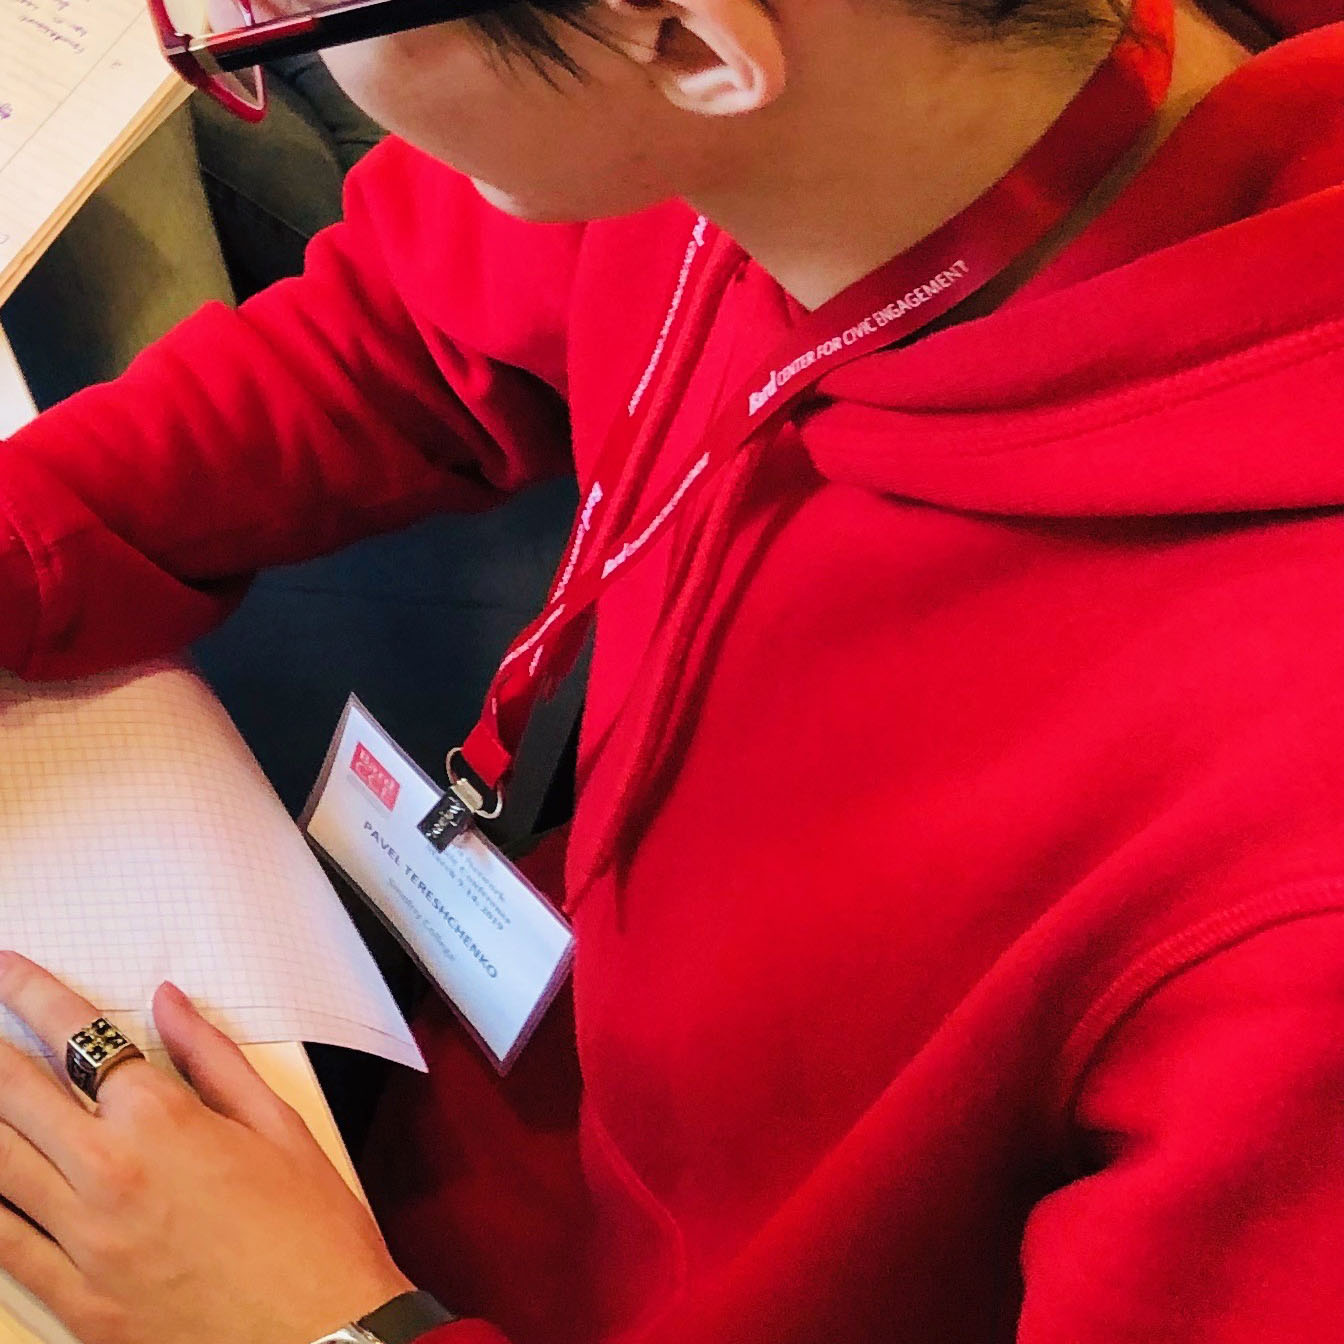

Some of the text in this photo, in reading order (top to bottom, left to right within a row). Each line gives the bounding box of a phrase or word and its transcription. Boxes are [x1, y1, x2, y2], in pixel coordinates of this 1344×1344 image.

[816, 336, 843, 361] FOR
[842, 316, 878, 346] CIVIC
[873, 259, 970, 328] ENGAGEMENT
[363, 820, 498, 979] PAVEL TERESHCHENKO
